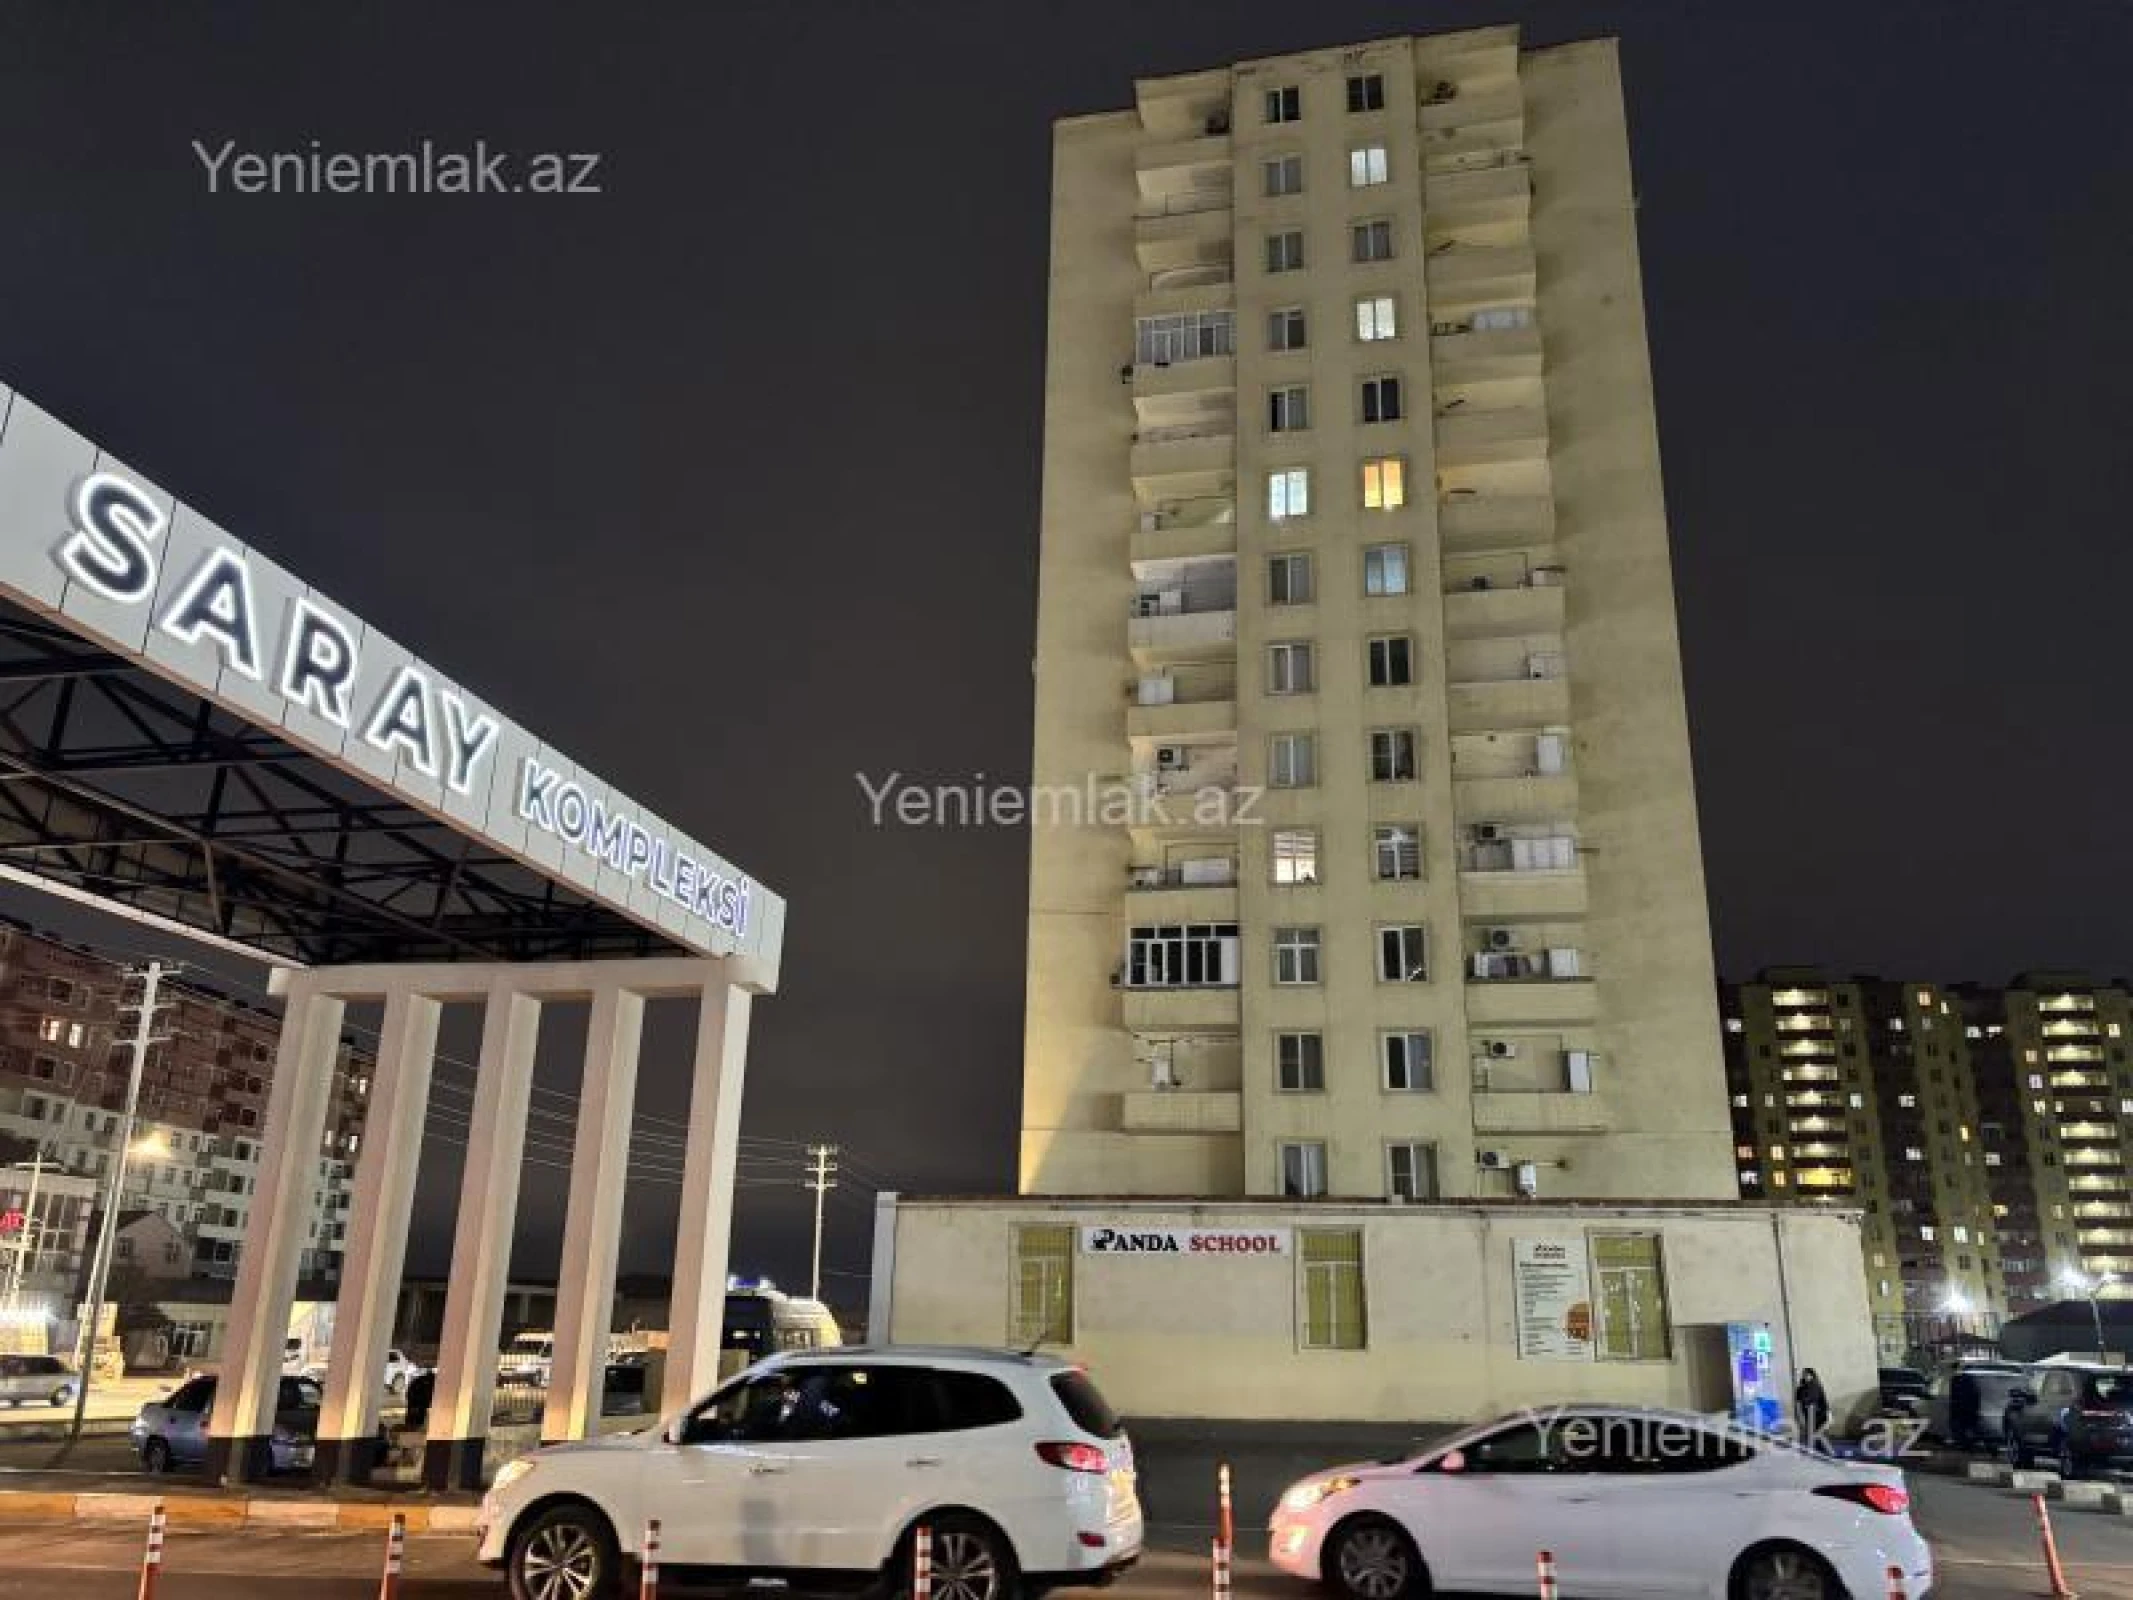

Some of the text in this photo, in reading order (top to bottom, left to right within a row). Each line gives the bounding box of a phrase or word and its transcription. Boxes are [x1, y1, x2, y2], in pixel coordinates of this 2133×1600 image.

[62, 473, 750, 939] SARAY KOMPLEKSİ
[1093, 1228, 1282, 1252] PANDA SCHOOL
